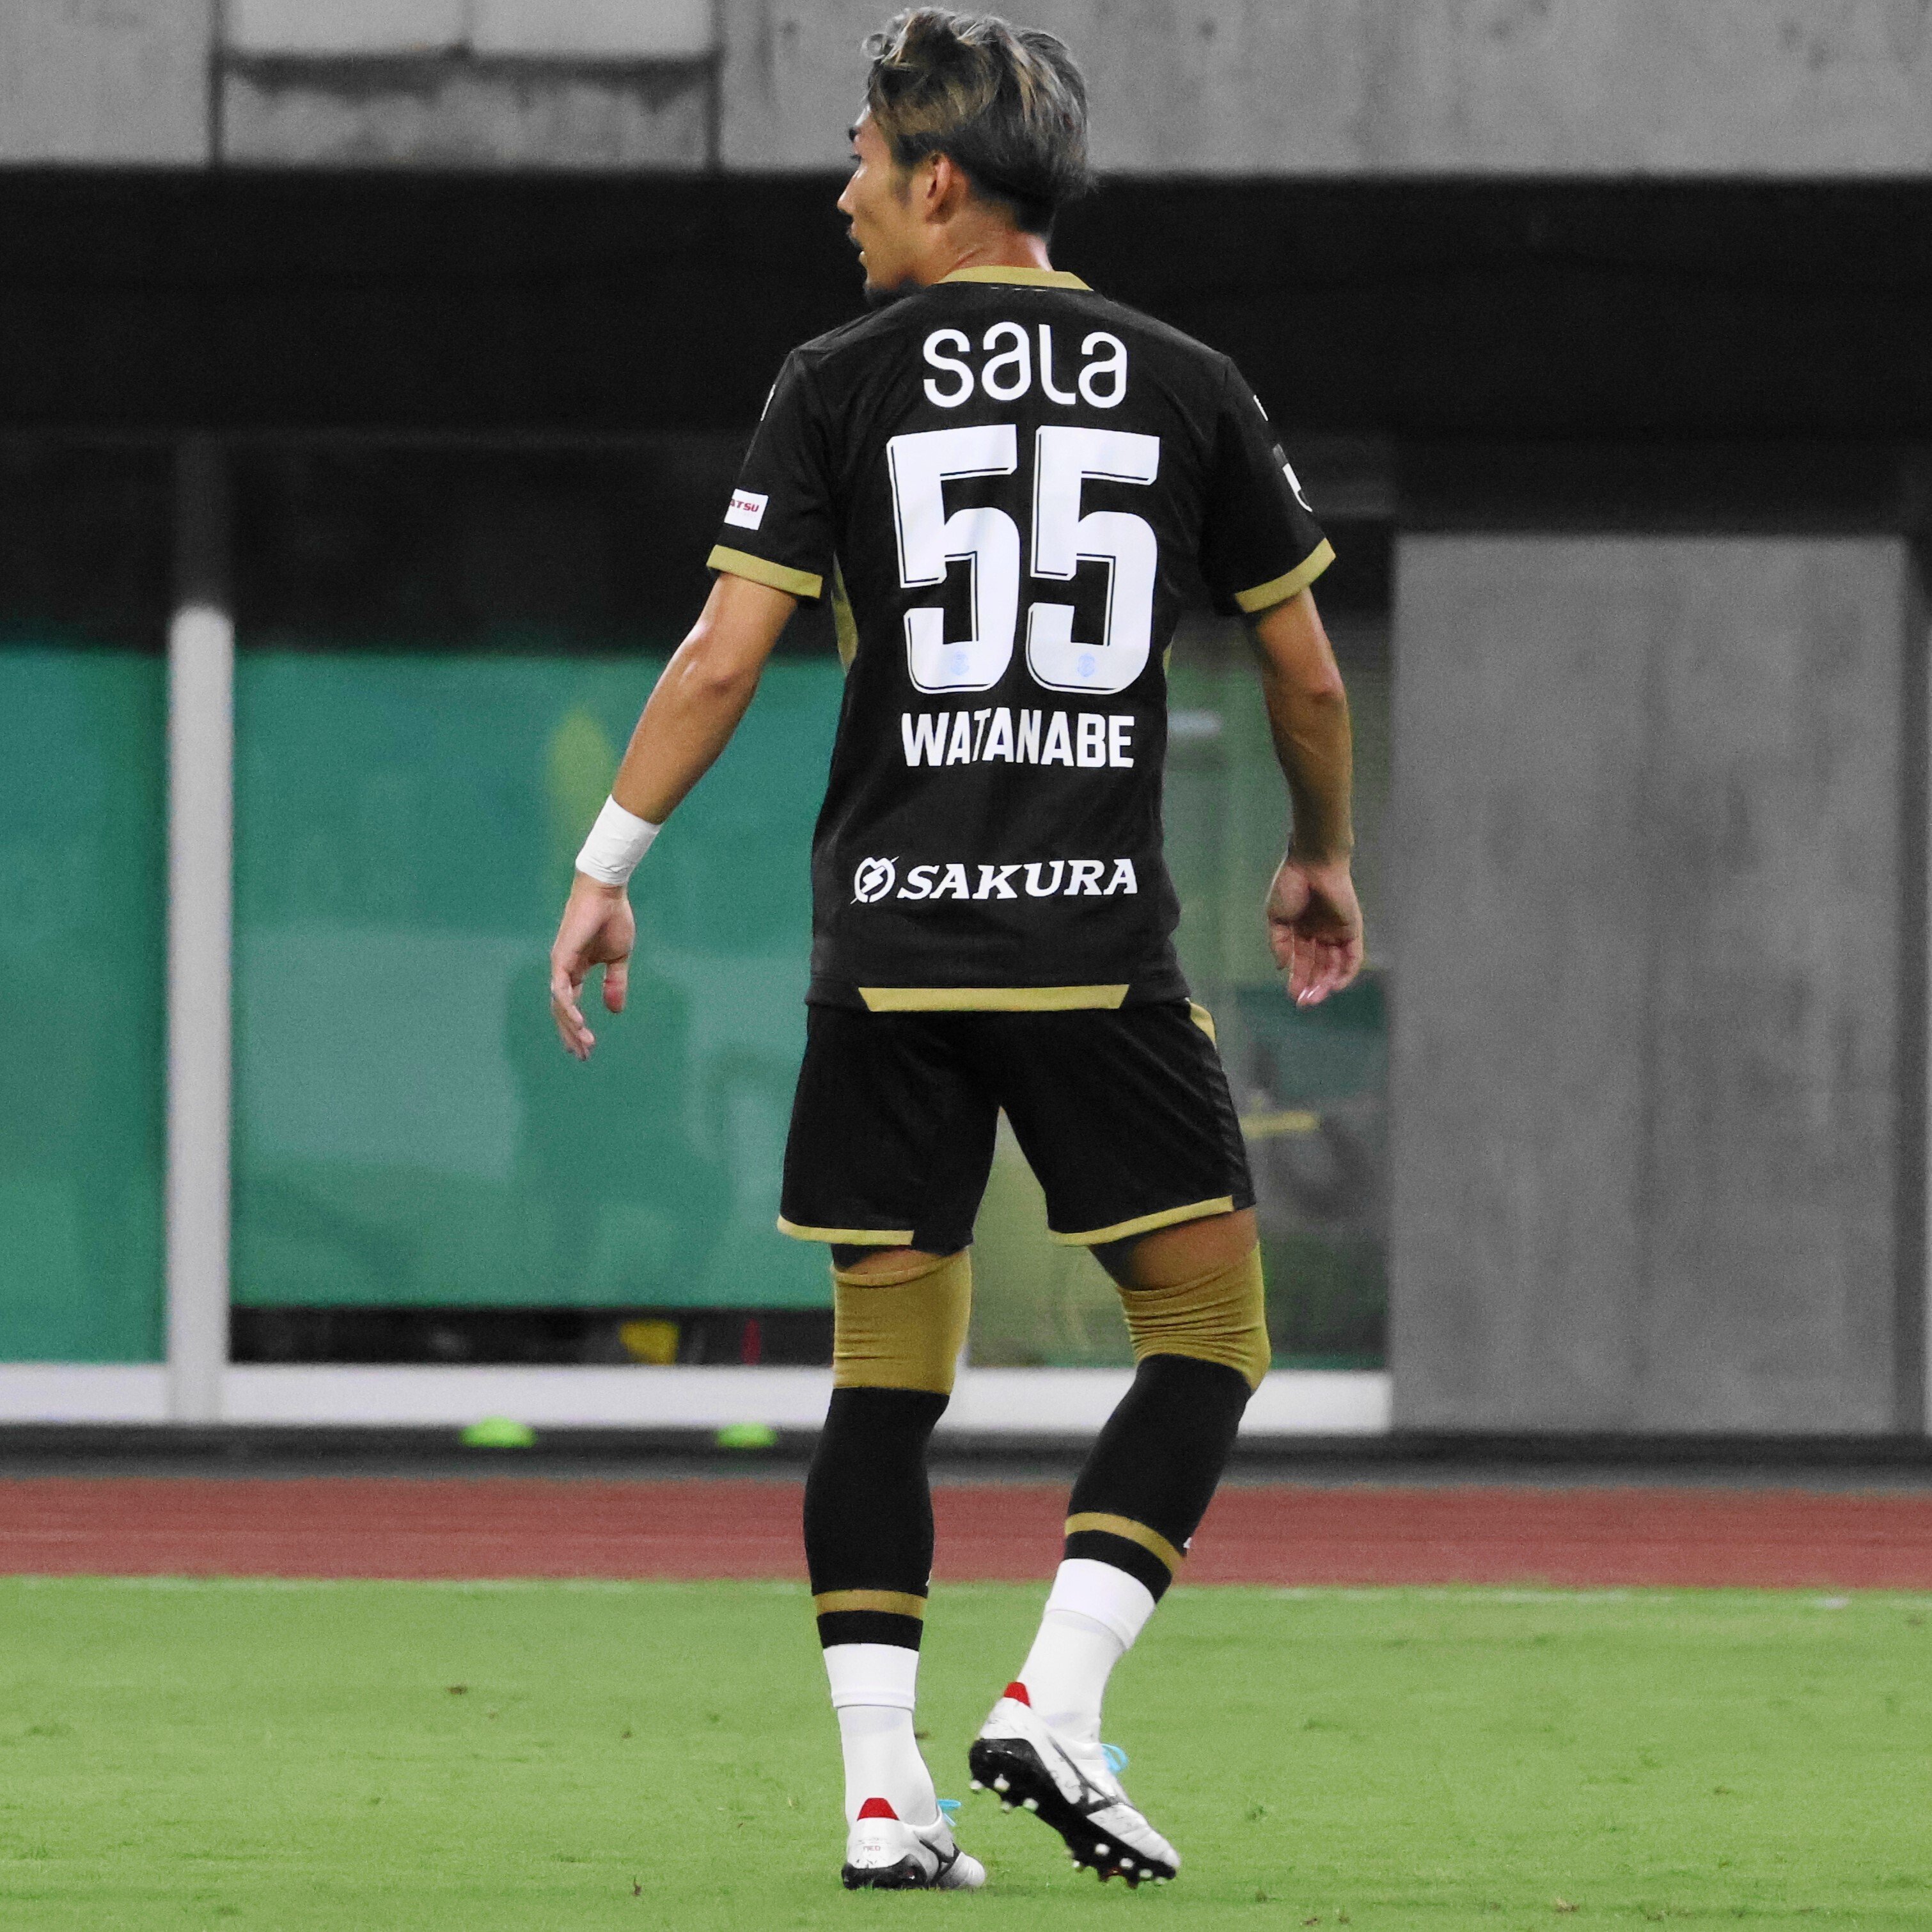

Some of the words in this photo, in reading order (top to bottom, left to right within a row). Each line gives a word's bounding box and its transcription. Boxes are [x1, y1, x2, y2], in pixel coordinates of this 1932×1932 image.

[886, 423, 1160, 695] 55
[901, 707, 1135, 768] WATANABE
[897, 858, 1138, 900] SAKURA
